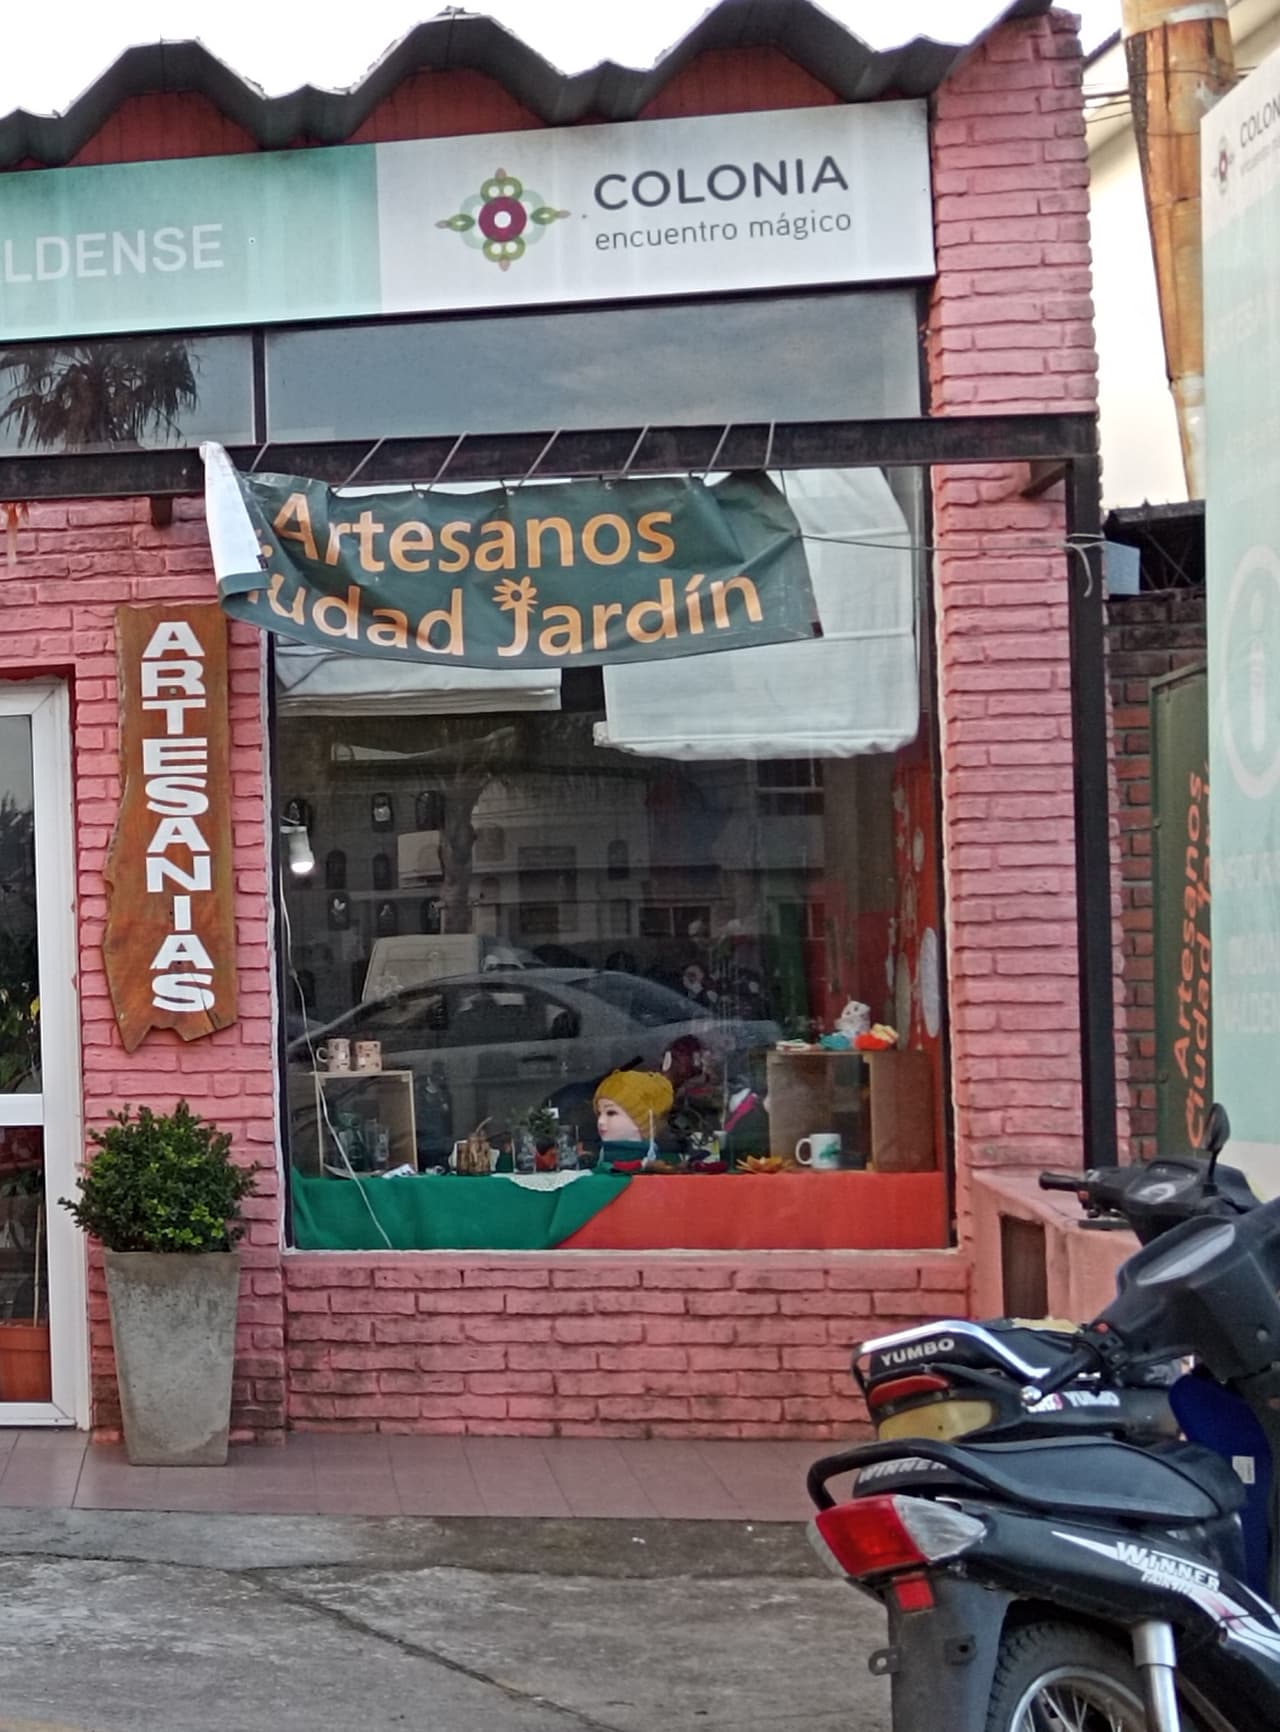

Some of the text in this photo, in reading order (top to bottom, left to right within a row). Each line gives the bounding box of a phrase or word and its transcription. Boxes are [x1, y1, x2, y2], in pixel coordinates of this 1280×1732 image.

[593, 155, 849, 211] COLONIA
[594, 212, 852, 251] encuentro mágico
[273, 492, 676, 573] Artesanos
[246, 552, 764, 658] udad Jardín
[141, 621, 216, 1014] ARTESANIAS
[1174, 771, 1203, 1078] Artesanos
[880, 1337, 955, 1368] YUMBO
[1116, 1541, 1220, 1592] WINNER
